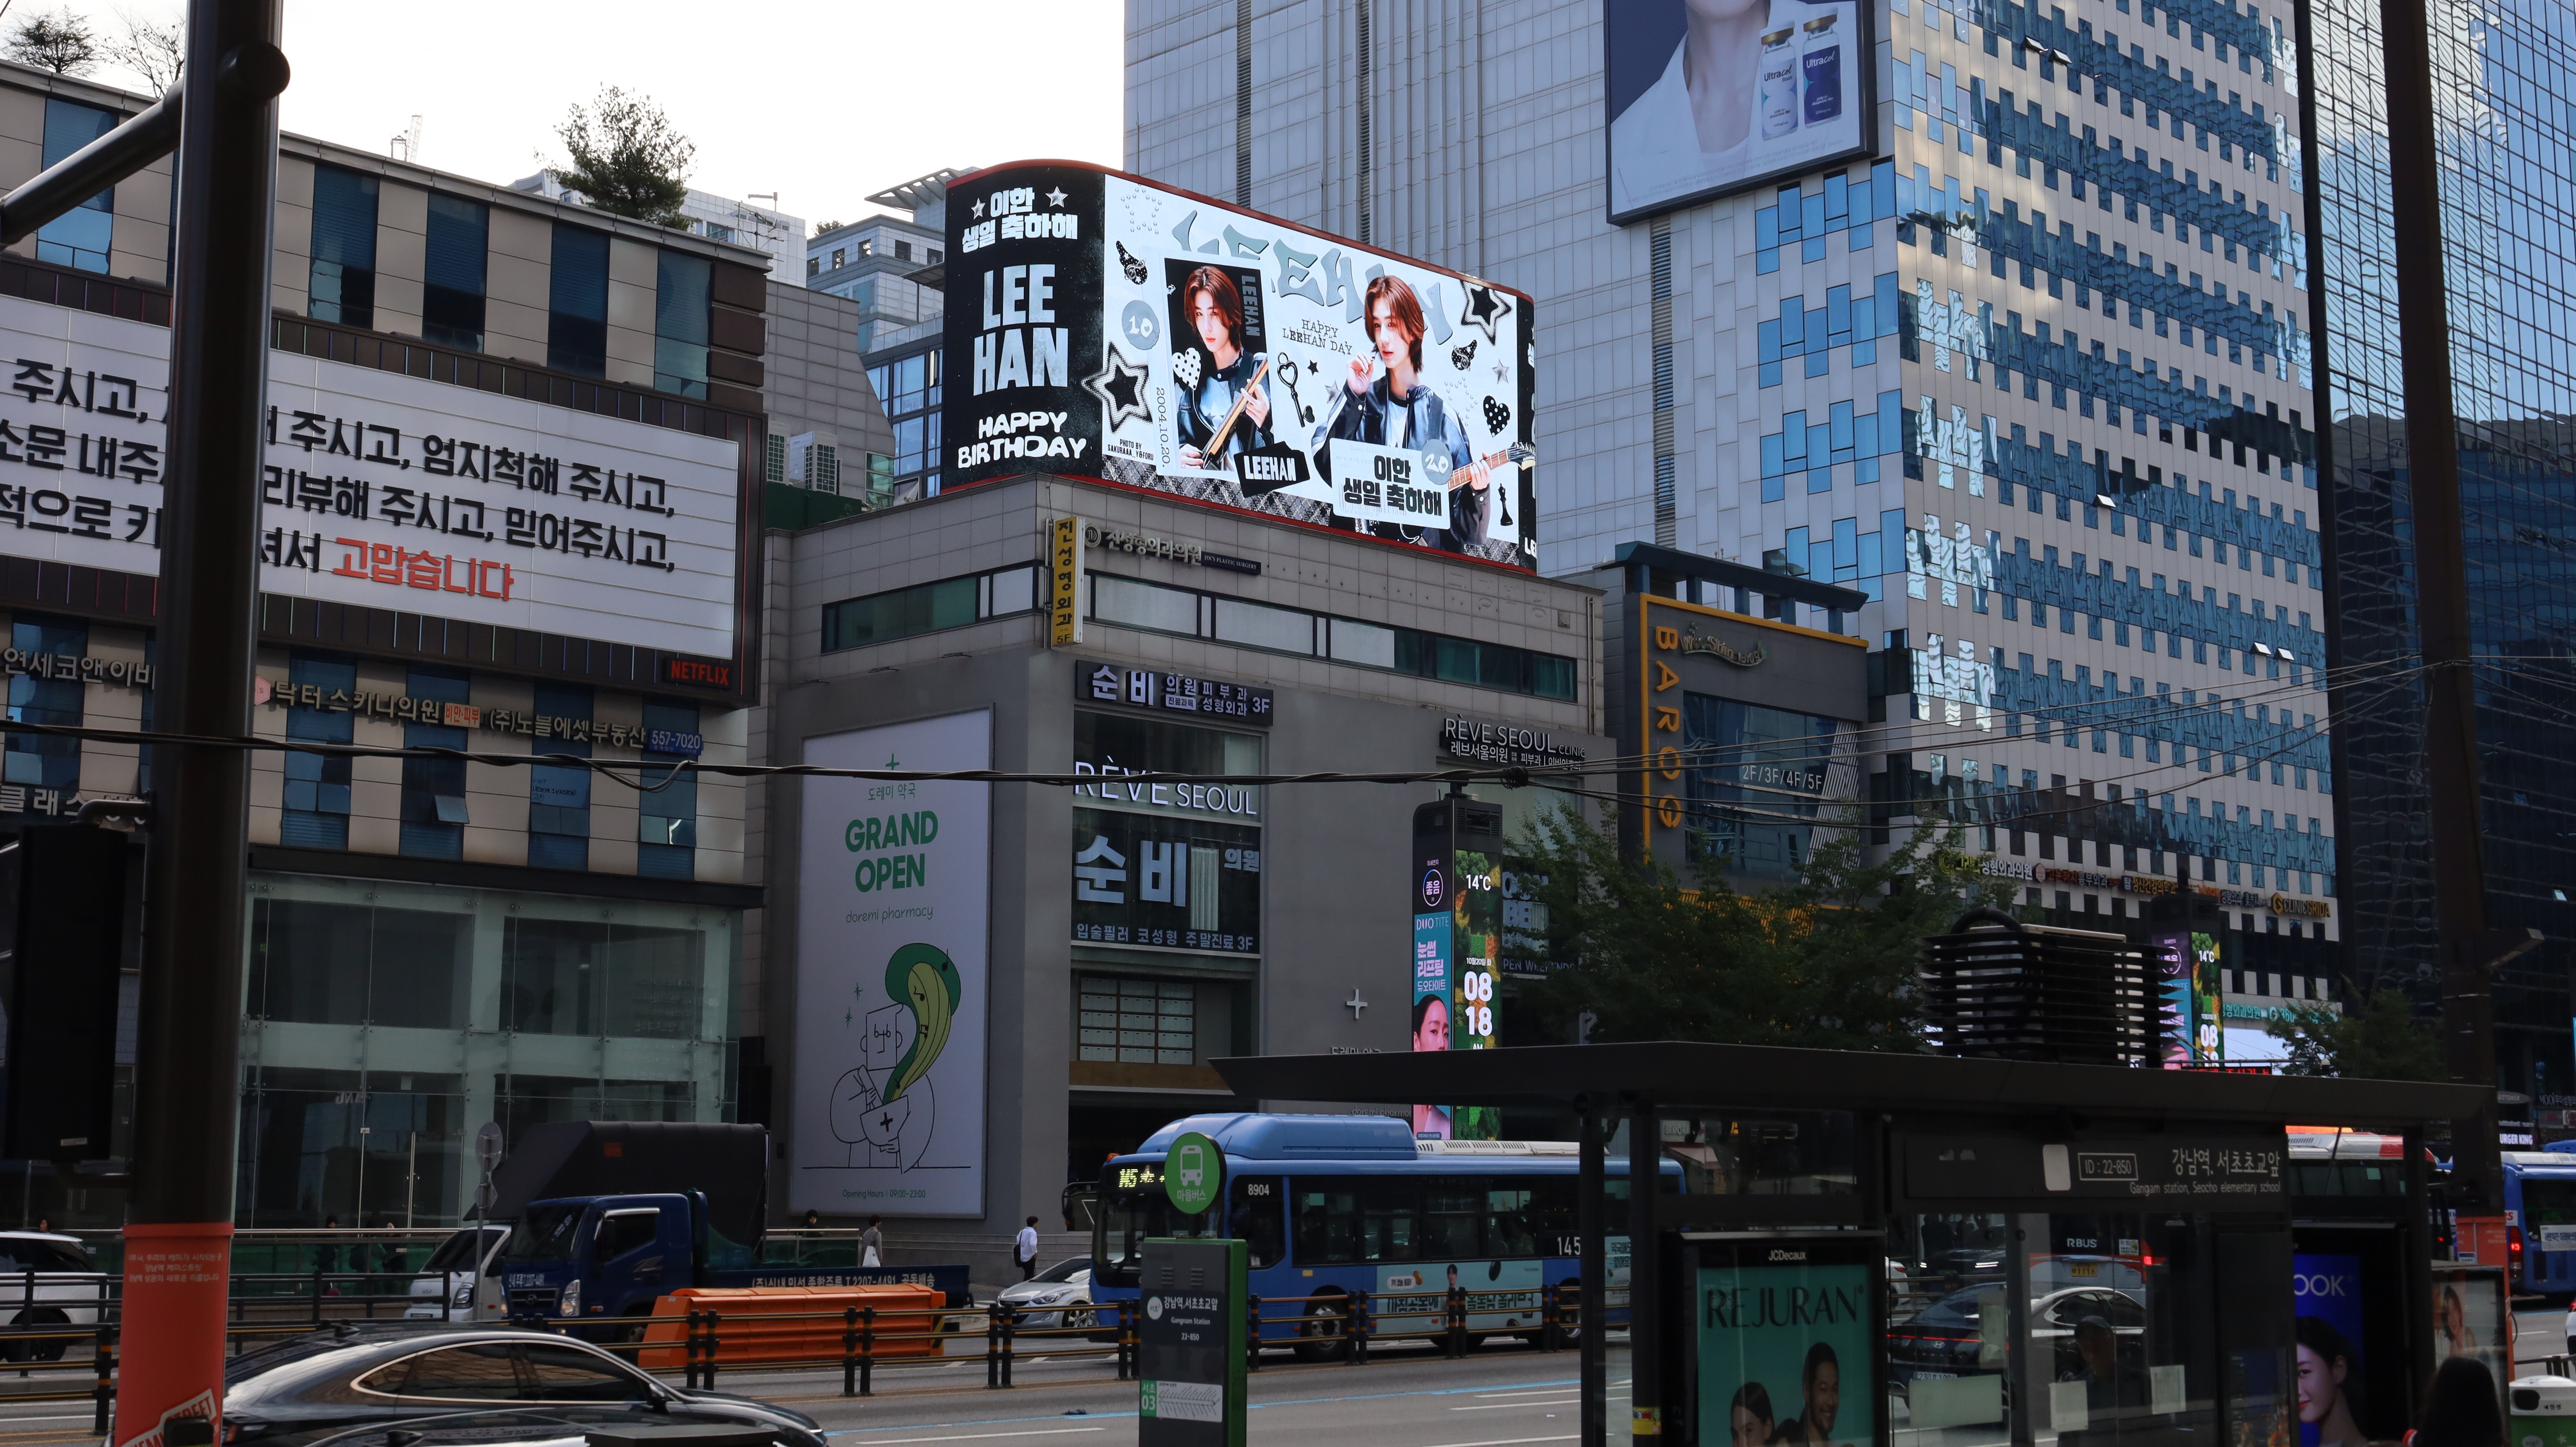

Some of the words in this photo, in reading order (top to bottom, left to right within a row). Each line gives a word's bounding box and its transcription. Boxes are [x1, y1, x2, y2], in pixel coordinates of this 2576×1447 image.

[1806, 50, 1835, 69] Ultracol
[1764, 64, 1792, 82] Ultracol
[991, 187, 1035, 217] 이한
[962, 219, 996, 253] 생일
[1002, 213, 1078, 240] 축하해
[983, 264, 1055, 330] LEE
[1241, 275, 1260, 337] LEEHAN
[1129, 315, 1153, 338] 10
[1302, 319, 1338, 339] HAPPY
[1283, 327, 1326, 350] LEEHAN
[1331, 338, 1353, 356] DAY
[973, 327, 1068, 396] HAN
[978, 412, 1068, 439] HAPPY
[13, 358, 148, 423] 주시고,
[291, 410, 410, 469] 주시고,
[423, 434, 559, 495] 엄지척해
[571, 462, 675, 517] 주시고,
[1120, 439, 1135, 448] PHOTO
[958, 436, 1087, 468] BIRTHDAY
[1244, 456, 1297, 482] LEEHAN
[1375, 455, 1411, 484] 이한
[1425, 454, 1449, 474] 20
[1343, 478, 1381, 508] 생일
[1387, 484, 1442, 517] 축하해
[381, 486, 494, 542] 주시고,
[506, 507, 675, 572] 믿어주시고,
[333, 537, 514, 601] 고맙습니다
[1056, 520, 1073, 627] 진성형외과
[1216, 557, 1236, 566] PLASTIC
[1236, 561, 1257, 569] SURGERY
[1057, 633, 1071, 643] 5F
[671, 660, 729, 686] NETFLIX
[1092, 665, 1154, 706] 순비
[1166, 676, 1197, 696] 의원
[1203, 681, 1248, 701] 피부과
[1203, 697, 1248, 716] 성형외과
[1252, 697, 1270, 714] 3F
[652, 730, 701, 749] 557-7020
[1444, 714, 1492, 744] RÈVE
[1497, 726, 1556, 753] SEOUL
[1558, 745, 1586, 758] CLINIC
[1451, 741, 1508, 763] 레브서울의원
[1521, 753, 1541, 766] 피부과
[1743, 765, 1822, 790] 2F/3F/4F/5F
[868, 785, 894, 801] 도레미
[897, 782, 916, 799] 약국
[1176, 783, 1257, 815] SEOUL
[845, 811, 939, 852] GRAND
[855, 853, 926, 893] OPEN
[1074, 835, 1187, 907] 순비
[1224, 849, 1260, 872] 의원
[1426, 880, 1440, 895] 좋음
[846, 909, 879, 923] doremi
[882, 906, 933, 924] pharmacy
[1077, 923, 1129, 942] 입술필러
[1138, 928, 1177, 946] 코성형
[1186, 932, 1234, 949] 주말진료
[1237, 935, 1253, 951] 3F
[1418, 940, 1436, 959] 눈썹
[1418, 959, 1444, 978] 리프팅
[1502, 958, 1522, 970] PEN
[1417, 979, 1446, 992] 듀오타이트
[1464, 971, 1493, 1002] 08
[1465, 1006, 1492, 1037] 18
[2200, 1024, 2218, 1047] 08
[2519, 1134, 2533, 1145] KING
[2085, 1161, 2094, 1174] ID
[2103, 1160, 2131, 1174] 22-850
[843, 1188, 867, 1199] Opening
[867, 1189, 884, 1198] Hours
[890, 1189, 926, 1198] 09:00-23:00
[1177, 1189, 1206, 1202] 마을버스
[1248, 1184, 1269, 1196] 8904
[2193, 1182, 2218, 1193] Seocho
[2221, 1181, 2257, 1194] elementary
[2260, 1180, 2281, 1193] school
[1557, 1236, 1581, 1256] 145
[1769, 1250, 1806, 1261] JCDecaux
[1707, 1284, 1857, 1328] REJURAN
[1171, 1317, 1193, 1325] Gangnam
[1181, 1333, 1199, 1341] 22-850
[1142, 1383, 1155, 1393] 서초
[1141, 1396, 1155, 1411] 03
